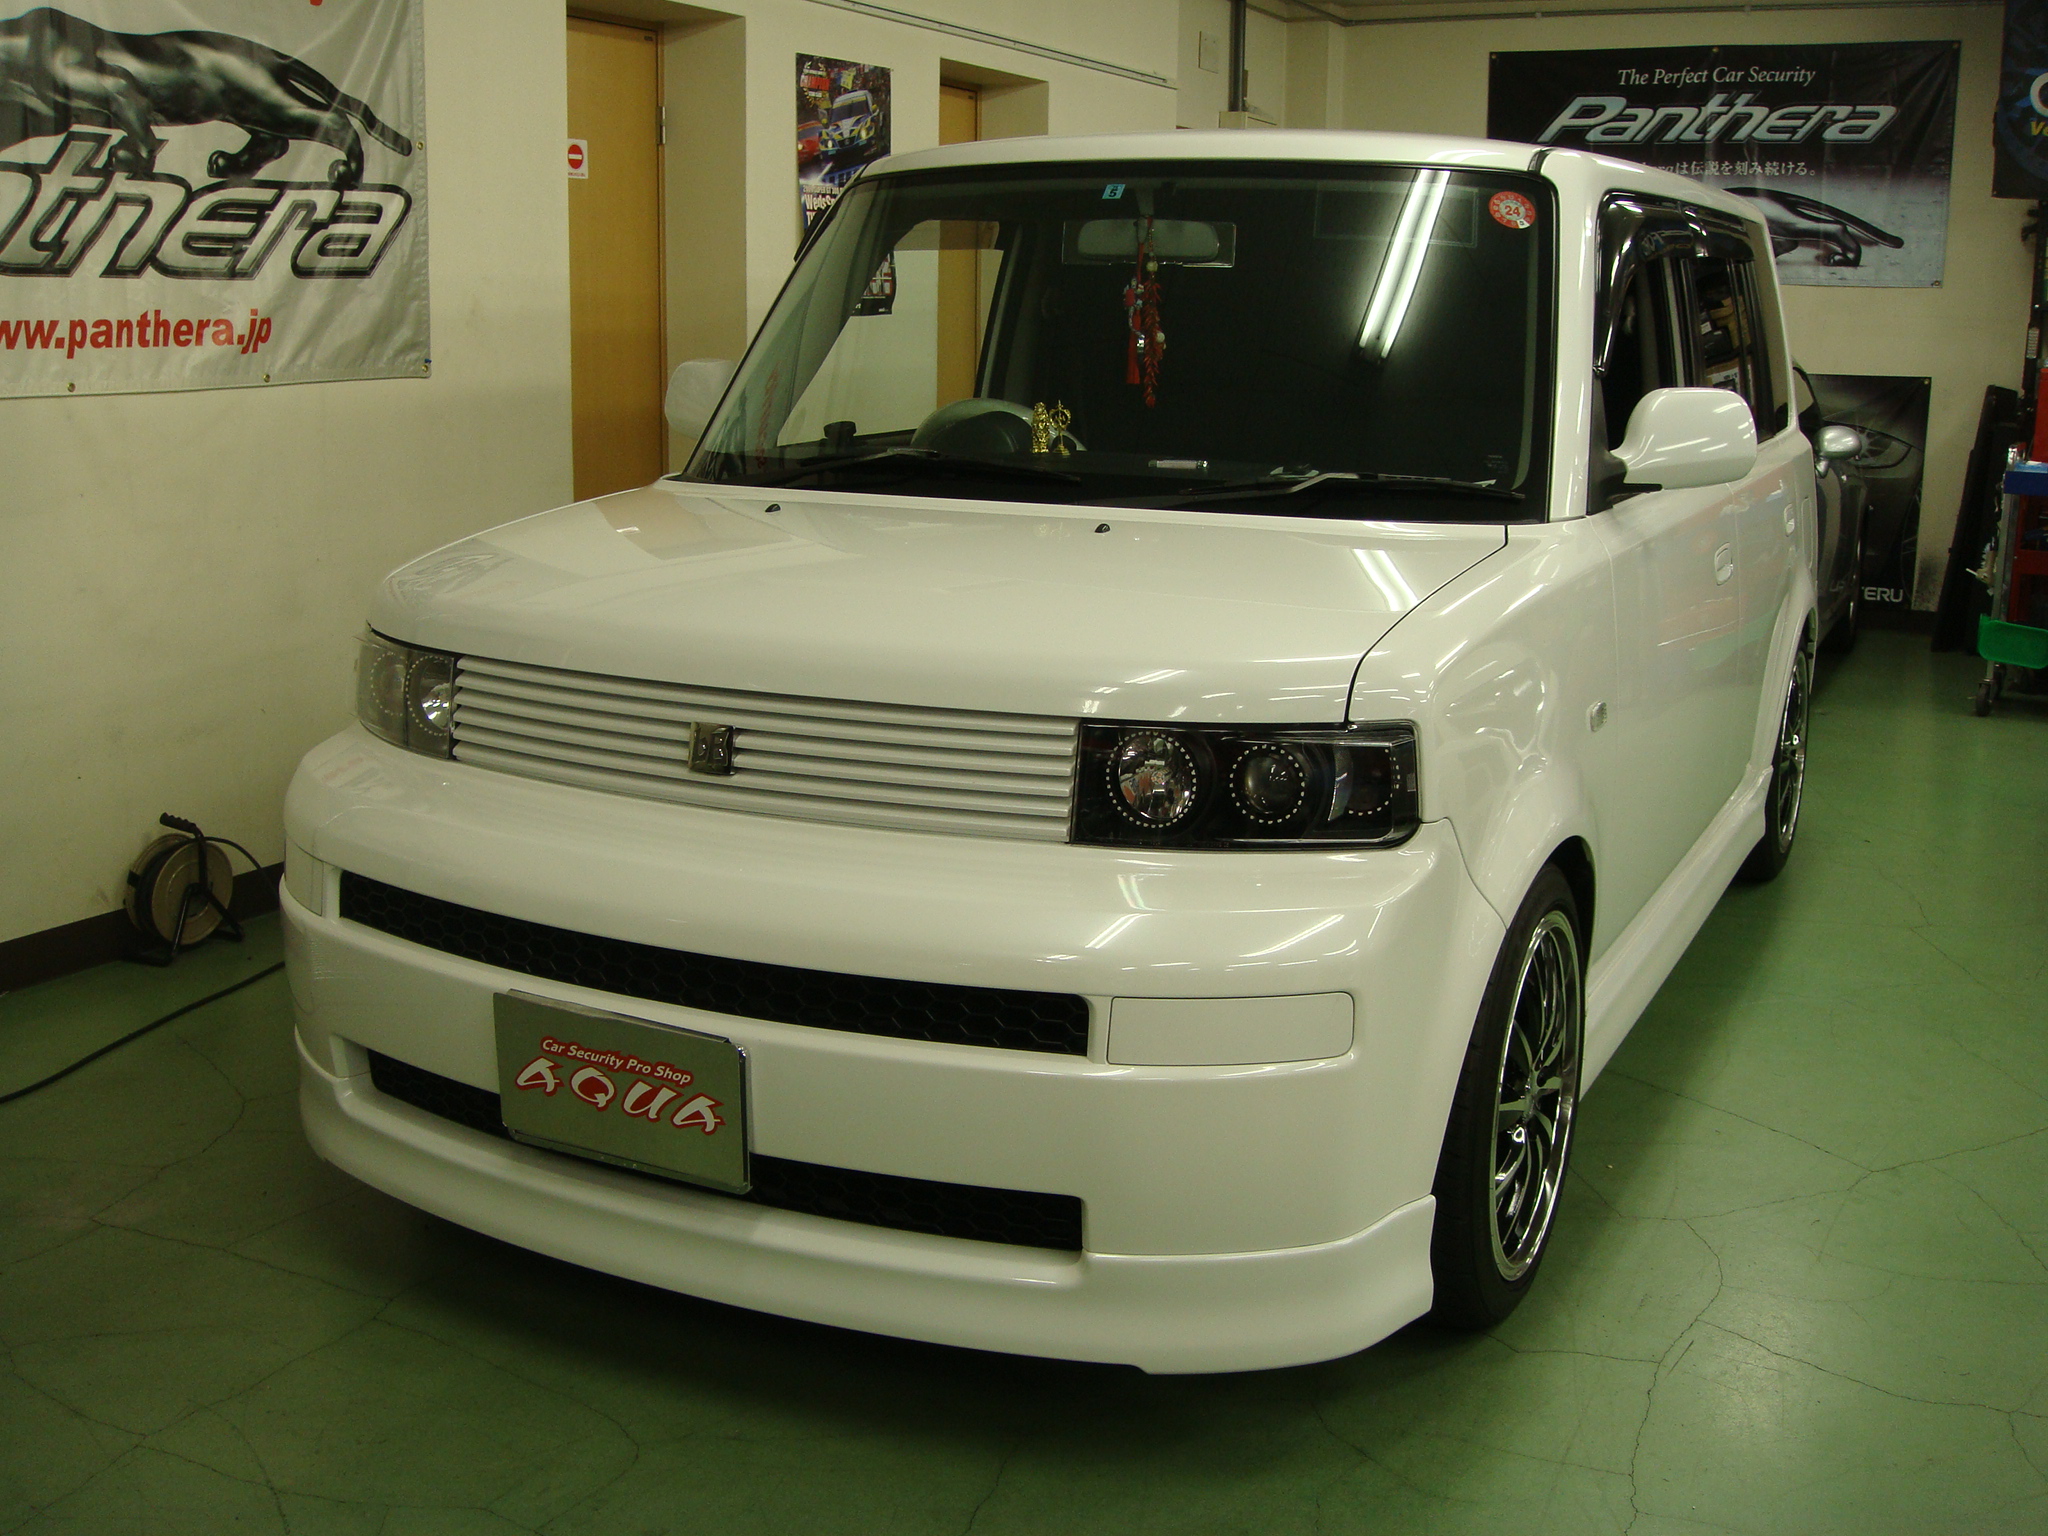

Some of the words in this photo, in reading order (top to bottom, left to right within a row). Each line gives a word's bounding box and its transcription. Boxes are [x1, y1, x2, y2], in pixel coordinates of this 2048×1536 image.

[1617, 69, 1648, 86] The
[1652, 66, 1708, 88] Perfect
[1713, 66, 1744, 83] Car
[1748, 65, 1816, 87] Security
[1505, 205, 1521, 217] 24
[1861, 586, 1904, 603] ERU
[542, 1039, 565, 1053] Car
[567, 1045, 624, 1069] Security
[626, 1058, 651, 1074] Pro
[654, 1065, 691, 1085] Shop
[516, 1057, 722, 1133] AQUA
